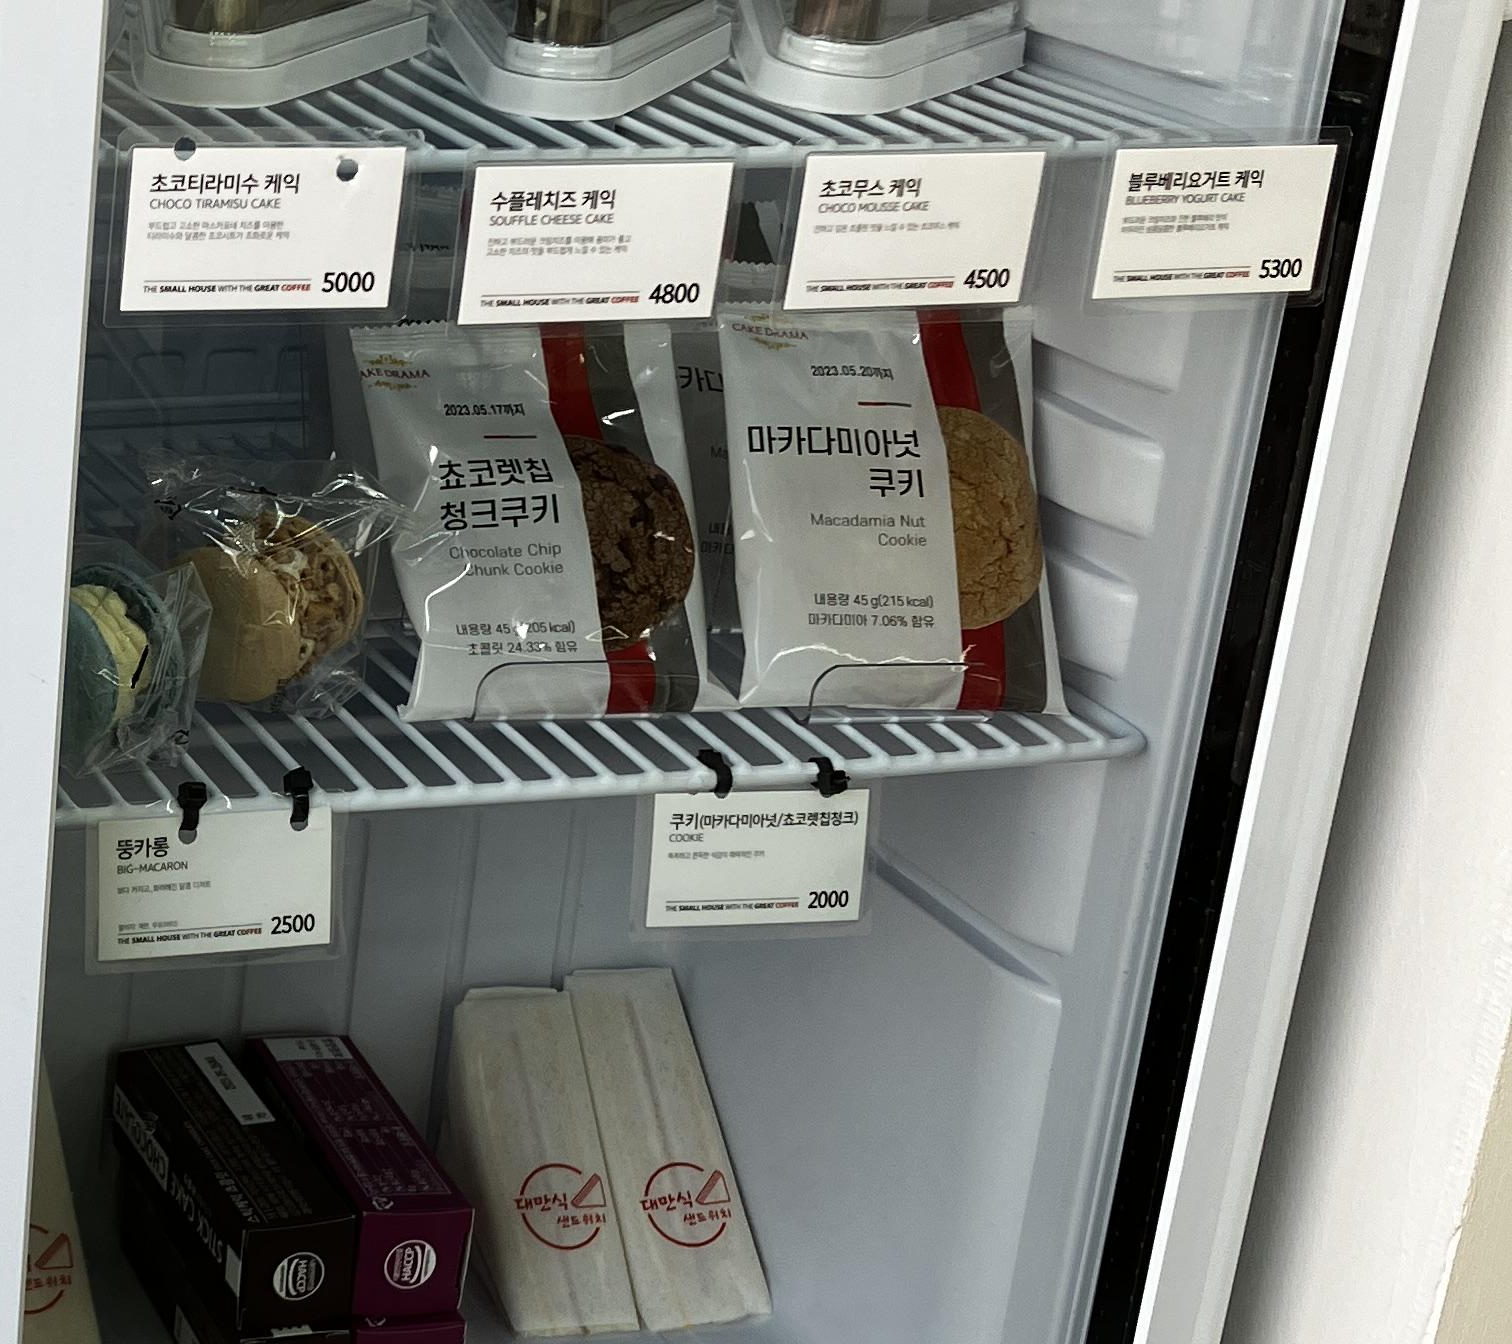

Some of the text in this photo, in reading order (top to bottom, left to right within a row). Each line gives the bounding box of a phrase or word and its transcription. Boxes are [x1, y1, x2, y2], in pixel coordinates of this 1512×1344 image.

[149, 172, 300, 194] 초코티라미수 케익
[818, 177, 922, 198] 초코무스 케익
[1128, 169, 1265, 192] 블루베리요거트 케익
[149, 197, 281, 210] CHOCO TIRAMISU CAKE
[490, 189, 617, 211] 수플레치즈 케익
[818, 200, 930, 214] CHOCO MOUSSE CAKE
[1125, 192, 1246, 206] BLUEBERRY YOGURT CAKE
[489, 213, 614, 226] SOUFFLE CHEESE CAKE
[1258, 258, 1303, 279] 5300
[321, 271, 375, 293] 5000
[963, 268, 1011, 289] 4500
[648, 283, 700, 304] 4800
[747, 425, 921, 459] 마카다미아넛
[438, 457, 554, 491] 쵸코렛칩
[869, 468, 925, 498] 쿠키
[439, 494, 560, 532] 청크쿠키
[810, 513, 926, 528] Macadamia Nut
[877, 532, 927, 547] Cookie
[449, 542, 562, 560] Chocolate Chip
[465, 561, 564, 578] Chunk Cookie
[814, 593, 849, 606] 내용량
[808, 613, 868, 626] 마카다미아
[911, 615, 934, 628] 함유
[669, 833, 704, 843] COOKIE
[116, 836, 170, 860] 뚱카롱
[117, 861, 188, 875] BIG-MACARON
[807, 890, 849, 909] 2000
[270, 913, 315, 935] 2500
[131, 935, 155, 944] SMALL
[156, 933, 181, 942] HOUSE
[213, 929, 236, 938] GREAT
[237, 927, 262, 936] COFFEE
[513, 1192, 568, 1212] 대만식
[639, 1191, 694, 1212] 대만식
[556, 1213, 607, 1228] 샌드위치
[683, 1208, 732, 1226] 샌드위치
